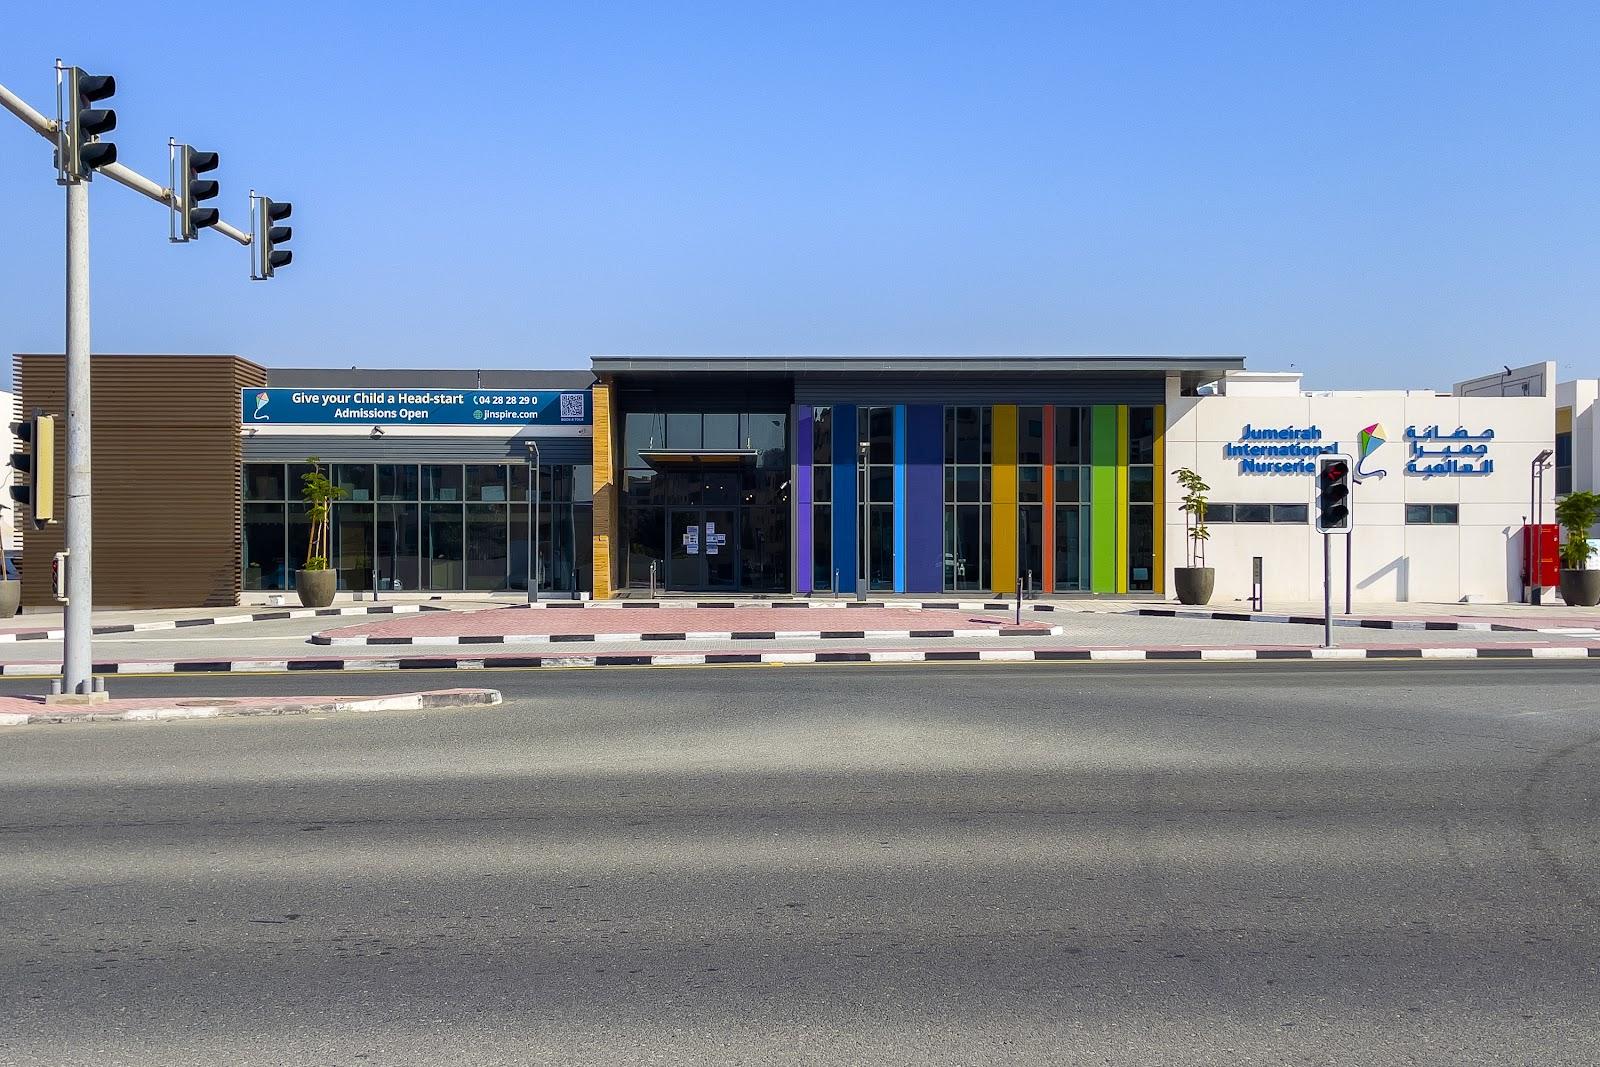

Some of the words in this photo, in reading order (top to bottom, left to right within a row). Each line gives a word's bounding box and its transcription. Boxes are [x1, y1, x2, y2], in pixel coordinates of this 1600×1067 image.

[292, 392, 319, 404] Give
[321, 394, 350, 406] your
[353, 392, 384, 404] Child
[387, 395, 395, 404] a
[398, 392, 464, 404] Head-start
[479, 396, 490, 405] 04
[492, 396, 504, 405] 28
[505, 396, 517, 405] 28
[518, 396, 530, 405] 29
[334, 408, 397, 418] Admissions
[399, 408, 429, 420] Open
[1241, 424, 1322, 440] Jumeirah
[1405, 425, 1495, 439] حضانة
[1225, 442, 1338, 456] International
[1410, 441, 1488, 458] جميرا
[1241, 459, 1316, 472] Nurserie
[1406, 459, 1494, 477] العالمية
